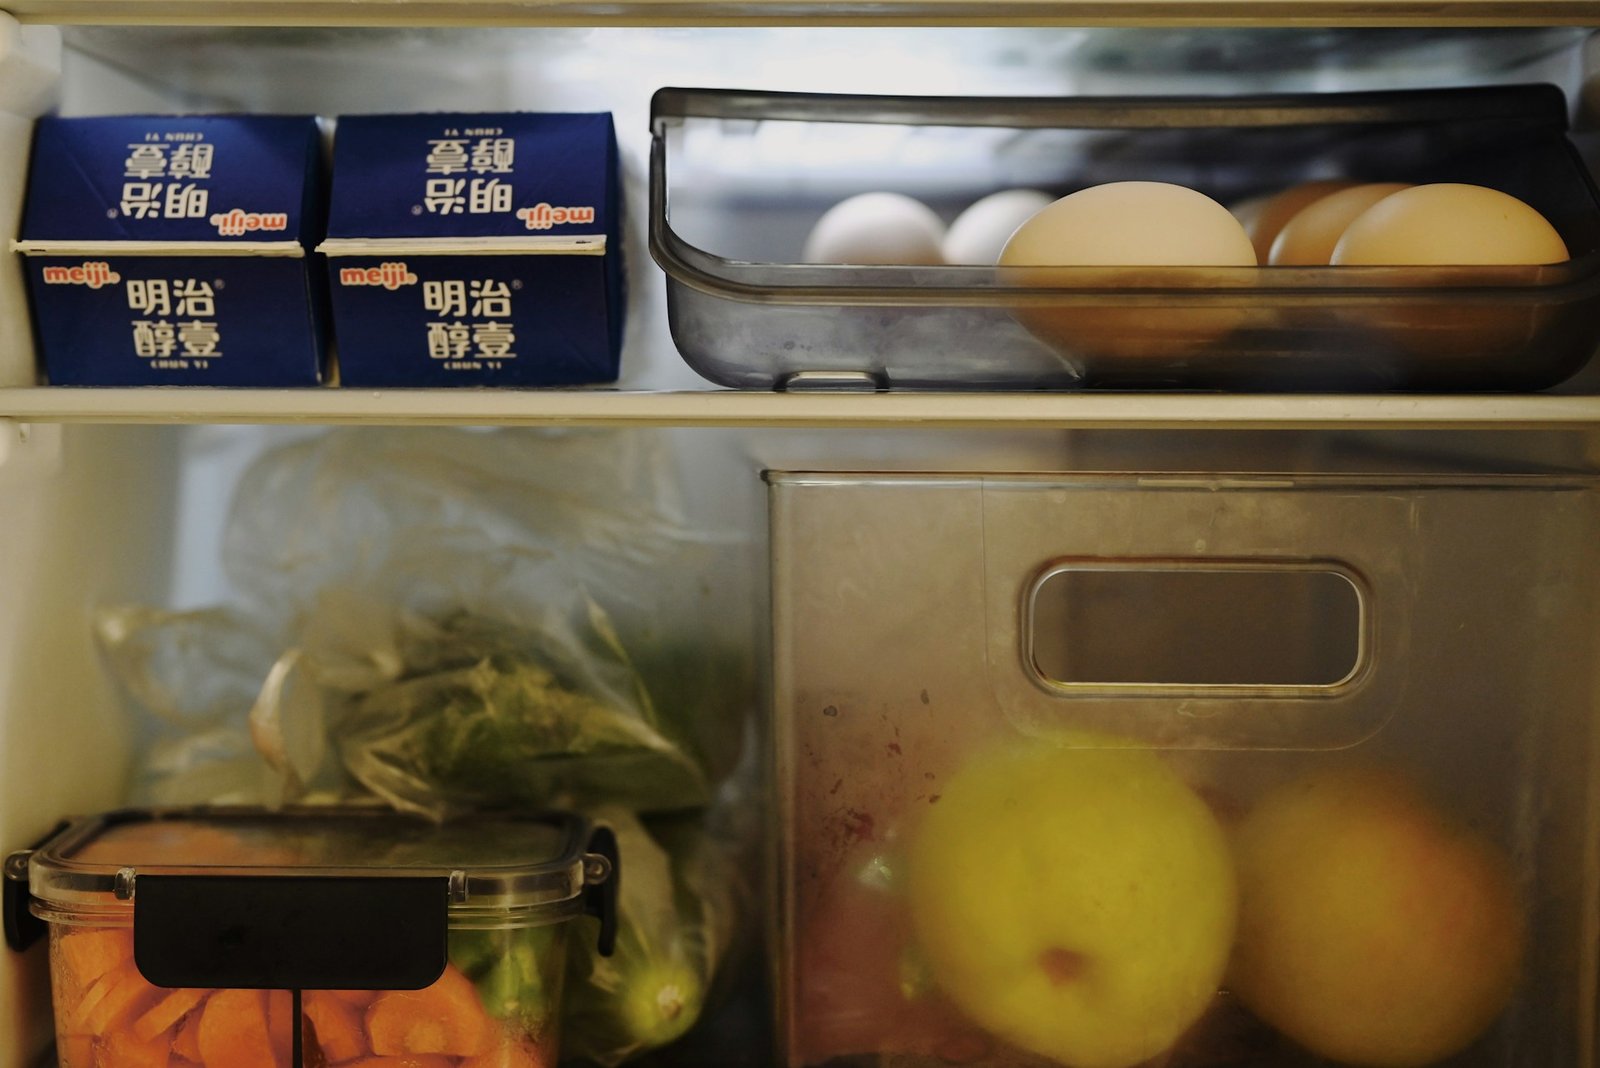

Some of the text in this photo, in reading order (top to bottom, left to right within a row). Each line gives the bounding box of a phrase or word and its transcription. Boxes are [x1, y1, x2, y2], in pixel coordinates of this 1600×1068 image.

[124, 144, 214, 179] 醇壹
[426, 138, 514, 174] 醇壹
[120, 182, 209, 219] 明治
[424, 178, 513, 215] 明治
[217, 209, 288, 236] meiji
[525, 203, 595, 230] meiji
[43, 262, 111, 288] meiji
[340, 262, 409, 290] meiji
[126, 279, 215, 316] 明治
[423, 279, 512, 317] 明治
[131, 320, 223, 358] 醇壹
[426, 321, 518, 359] 醇壹
